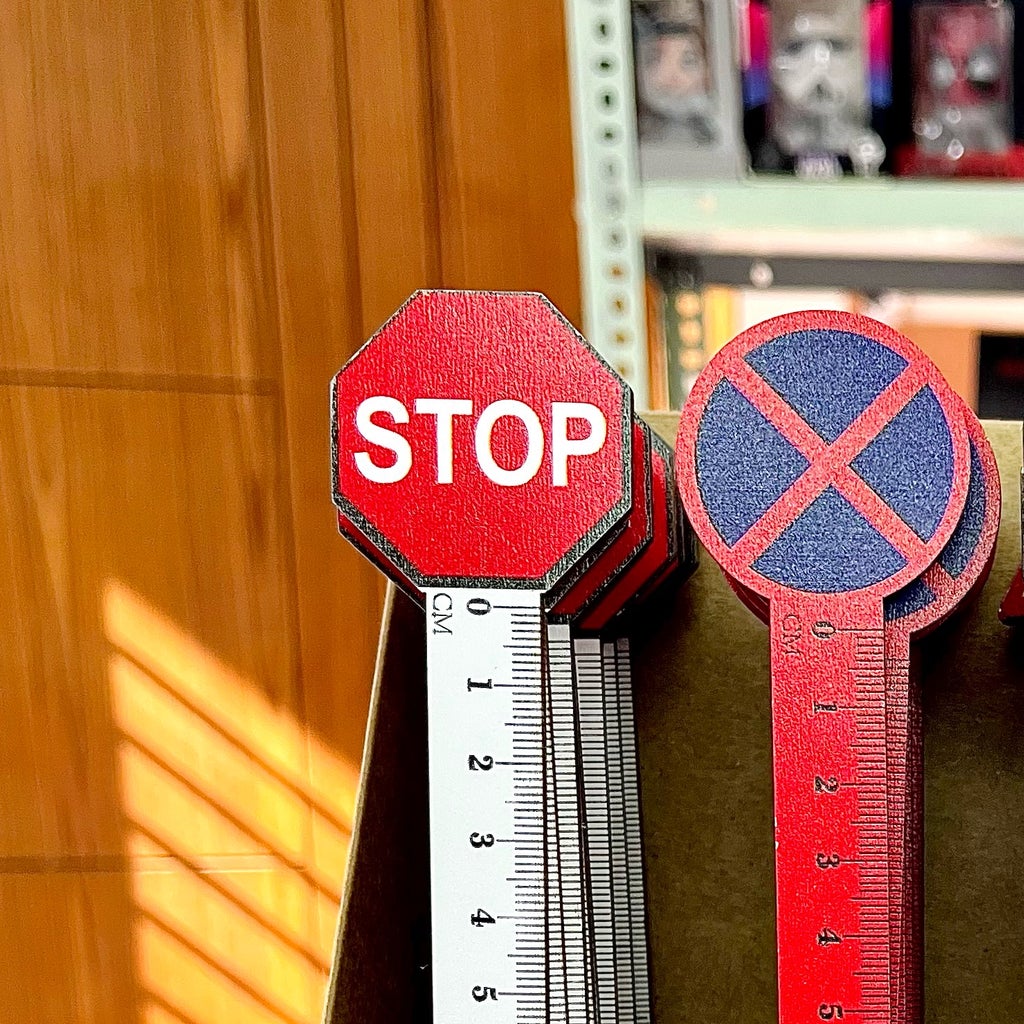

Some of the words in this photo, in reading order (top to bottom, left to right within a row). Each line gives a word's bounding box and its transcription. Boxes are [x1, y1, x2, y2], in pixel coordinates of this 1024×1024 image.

[353, 395, 607, 488] STOP
[432, 592, 453, 636] CM
[466, 597, 492, 616] 0
[781, 614, 801, 655] CM
[812, 620, 837, 639] 0
[466, 677, 493, 692] 1
[467, 754, 494, 772] 2
[814, 776, 840, 794] 2
[469, 832, 495, 849] 3
[816, 852, 840, 869] 3
[470, 908, 496, 928] 4
[816, 927, 842, 946] 4
[471, 985, 499, 1002] 5
[819, 1003, 844, 1021] 5
